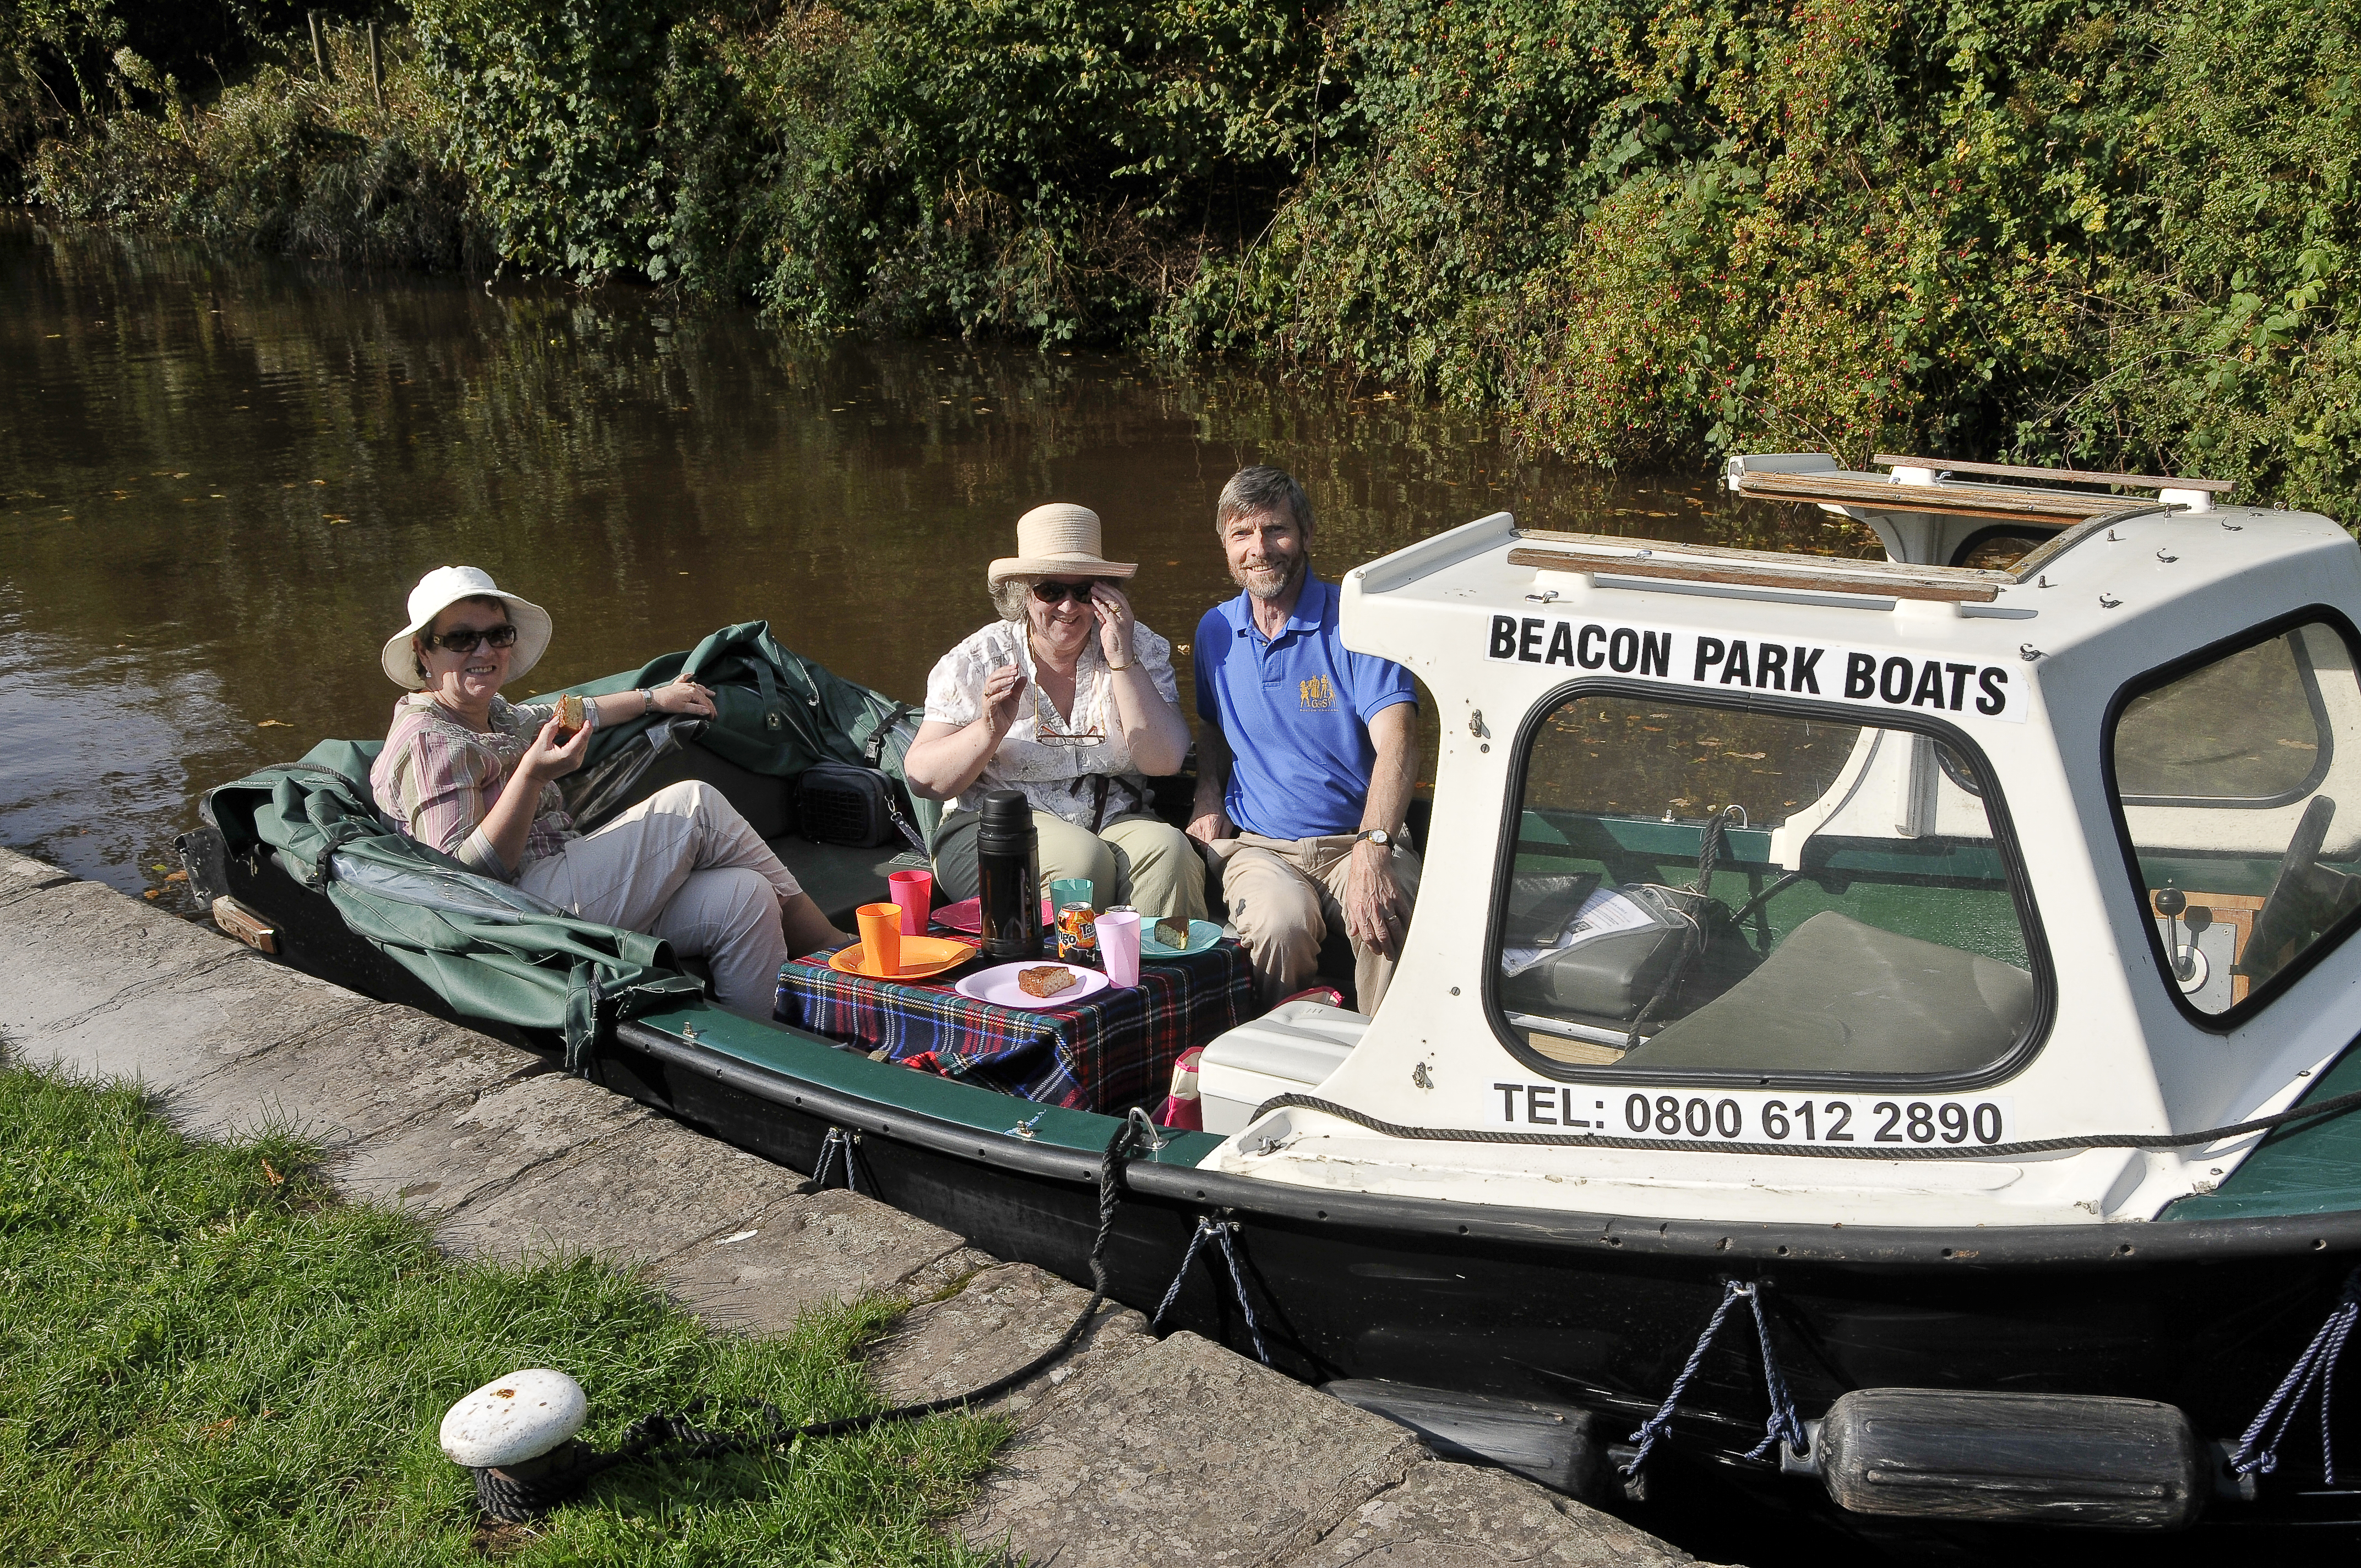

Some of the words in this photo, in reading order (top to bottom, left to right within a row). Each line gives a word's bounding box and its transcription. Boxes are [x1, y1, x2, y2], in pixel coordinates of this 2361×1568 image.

[1489, 615, 1672, 677] BEACON
[1693, 636, 1825, 695] PARK
[1844, 652, 2008, 716] BOATS
[1494, 1083, 1604, 1129] TEL:
[1625, 1093, 1742, 1139] 0800
[1761, 1100, 1854, 1141] 612
[1873, 1102, 2003, 1145] 2890
